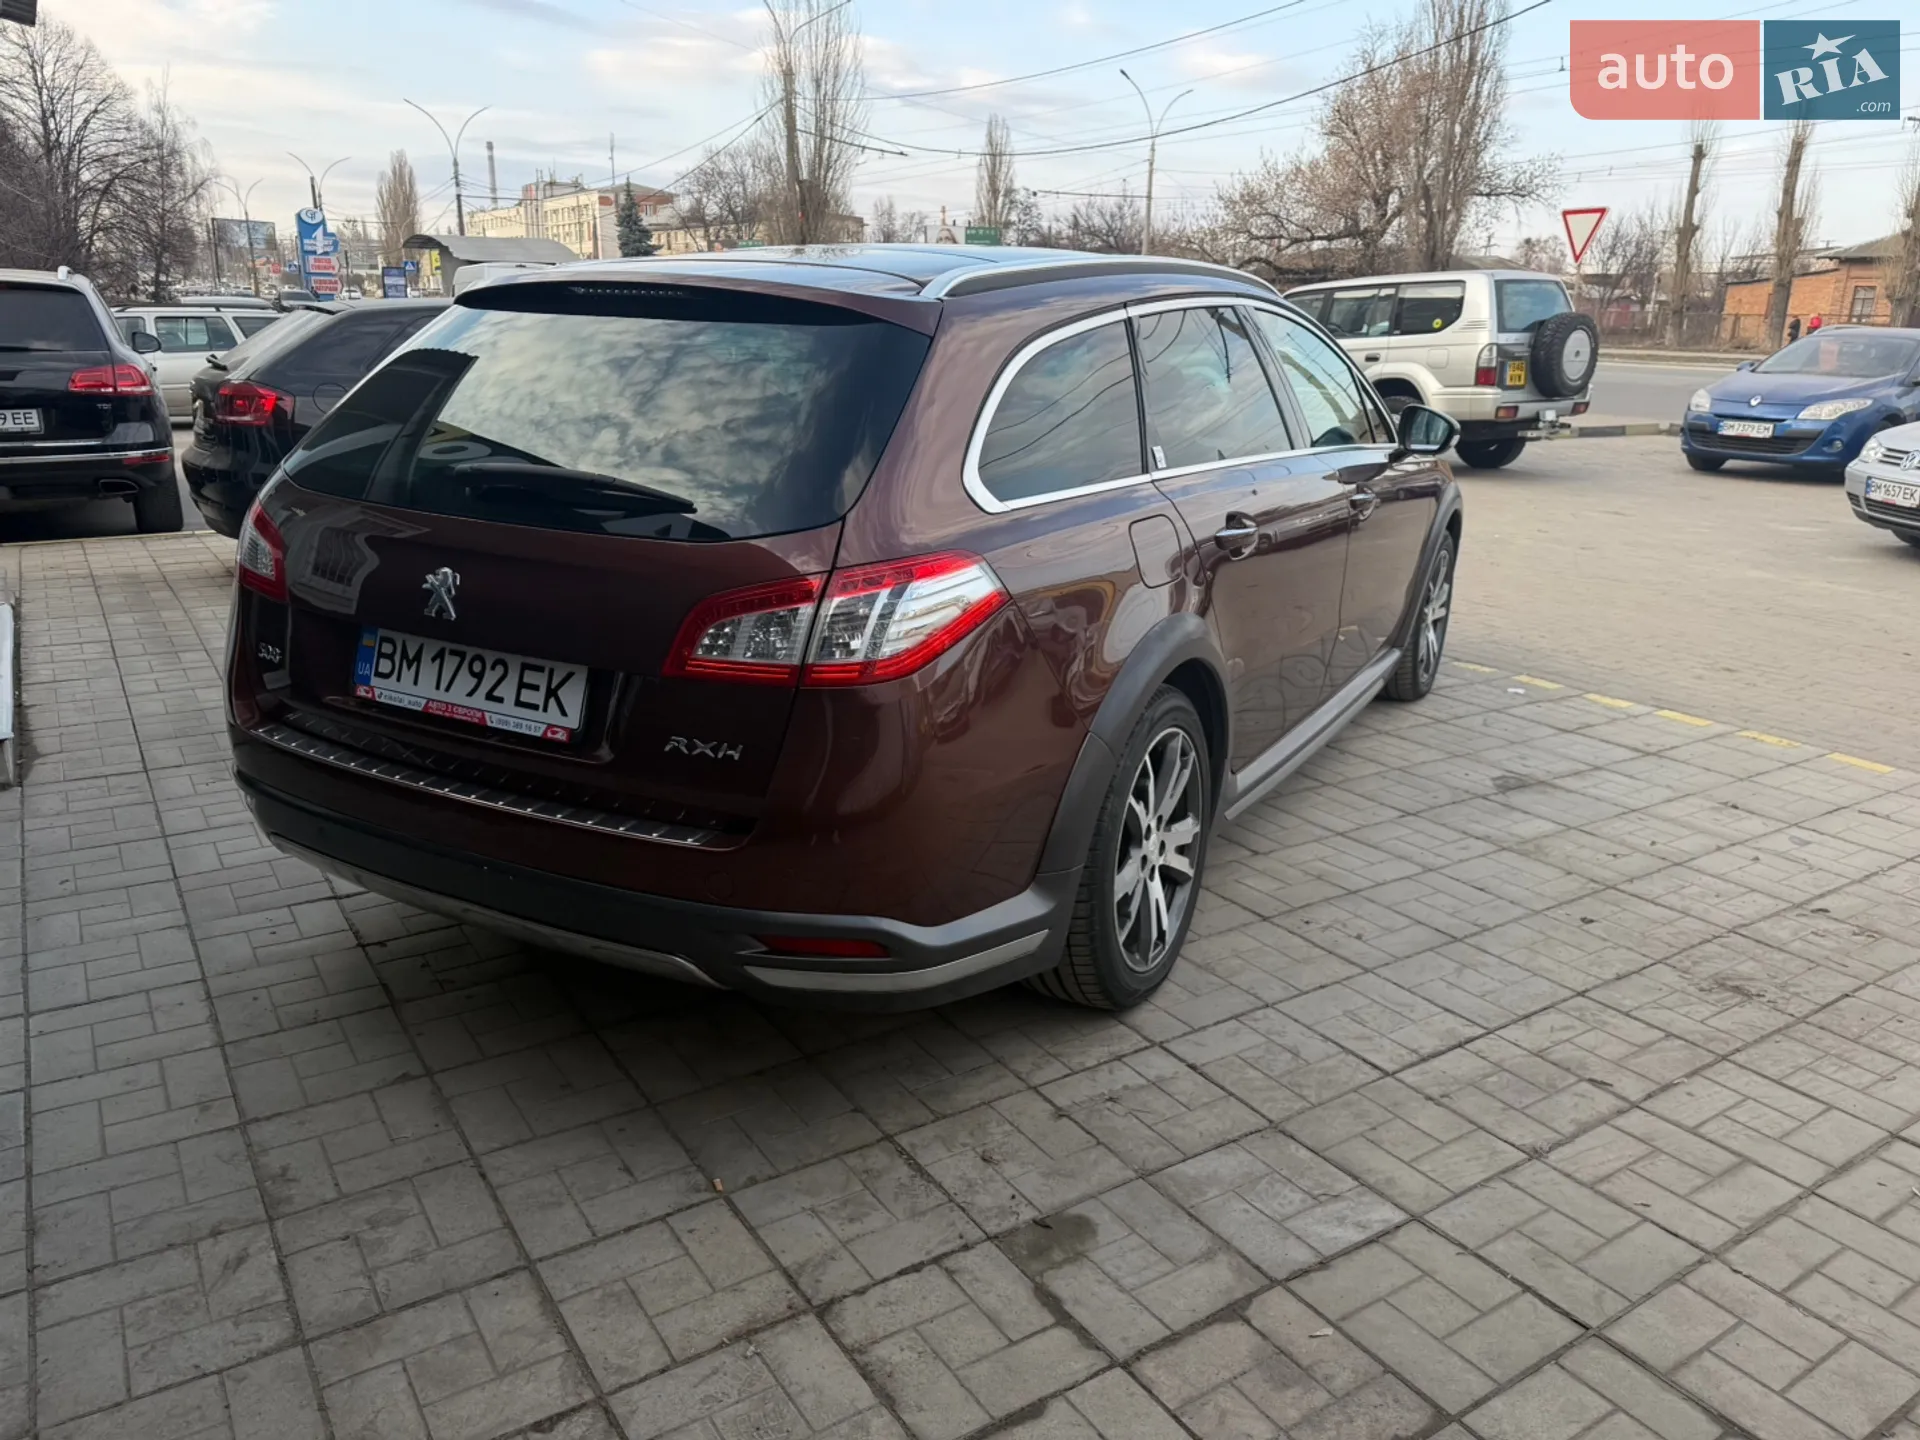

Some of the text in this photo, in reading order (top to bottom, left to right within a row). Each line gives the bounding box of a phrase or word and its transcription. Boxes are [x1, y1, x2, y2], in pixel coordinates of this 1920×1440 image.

[11, 412, 35, 426] EE
[1903, 486, 1918, 501] EK
[358, 661, 371, 676] UA
[373, 636, 576, 717] BM 1792 EK
[664, 735, 744, 760] RXH
